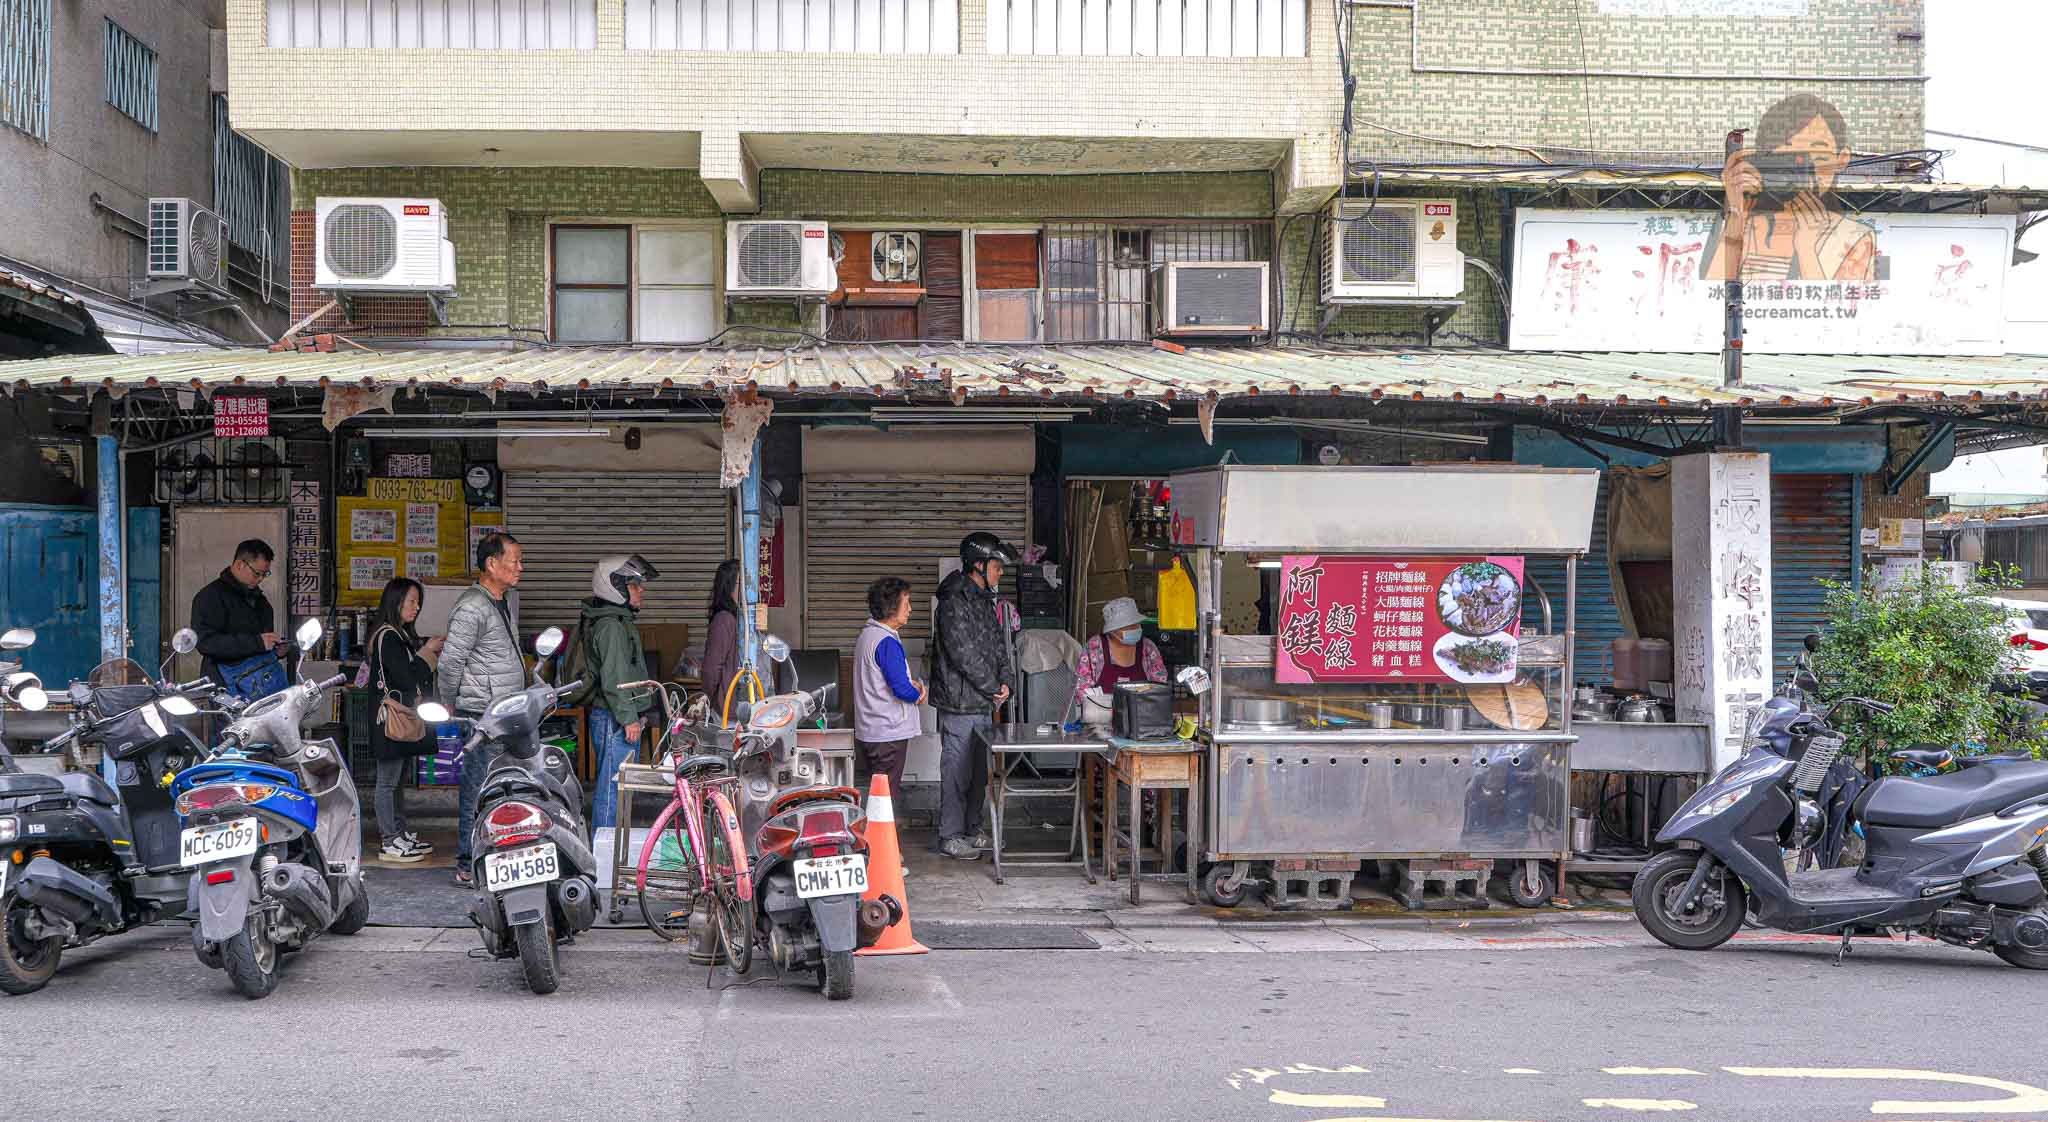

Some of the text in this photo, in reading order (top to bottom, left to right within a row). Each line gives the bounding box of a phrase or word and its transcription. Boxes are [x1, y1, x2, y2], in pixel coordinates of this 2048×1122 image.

[214, 398, 267, 415] 套/雅房出租
[214, 416, 268, 425] 0933-055434
[215, 426, 269, 436] 0921-126088
[374, 480, 453, 500] 0933-763-410
[289, 481, 318, 614] 本區精選物件
[1375, 571, 1426, 583] 招牌麵線
[1375, 596, 1425, 608] 大腸麵線
[1280, 565, 1324, 656] 阿鎂
[1373, 611, 1424, 623] 蚵仔麵線
[1325, 602, 1357, 671] 麵線
[1373, 625, 1423, 637] 花枝麵線
[1372, 640, 1422, 652] 肉羹麵線
